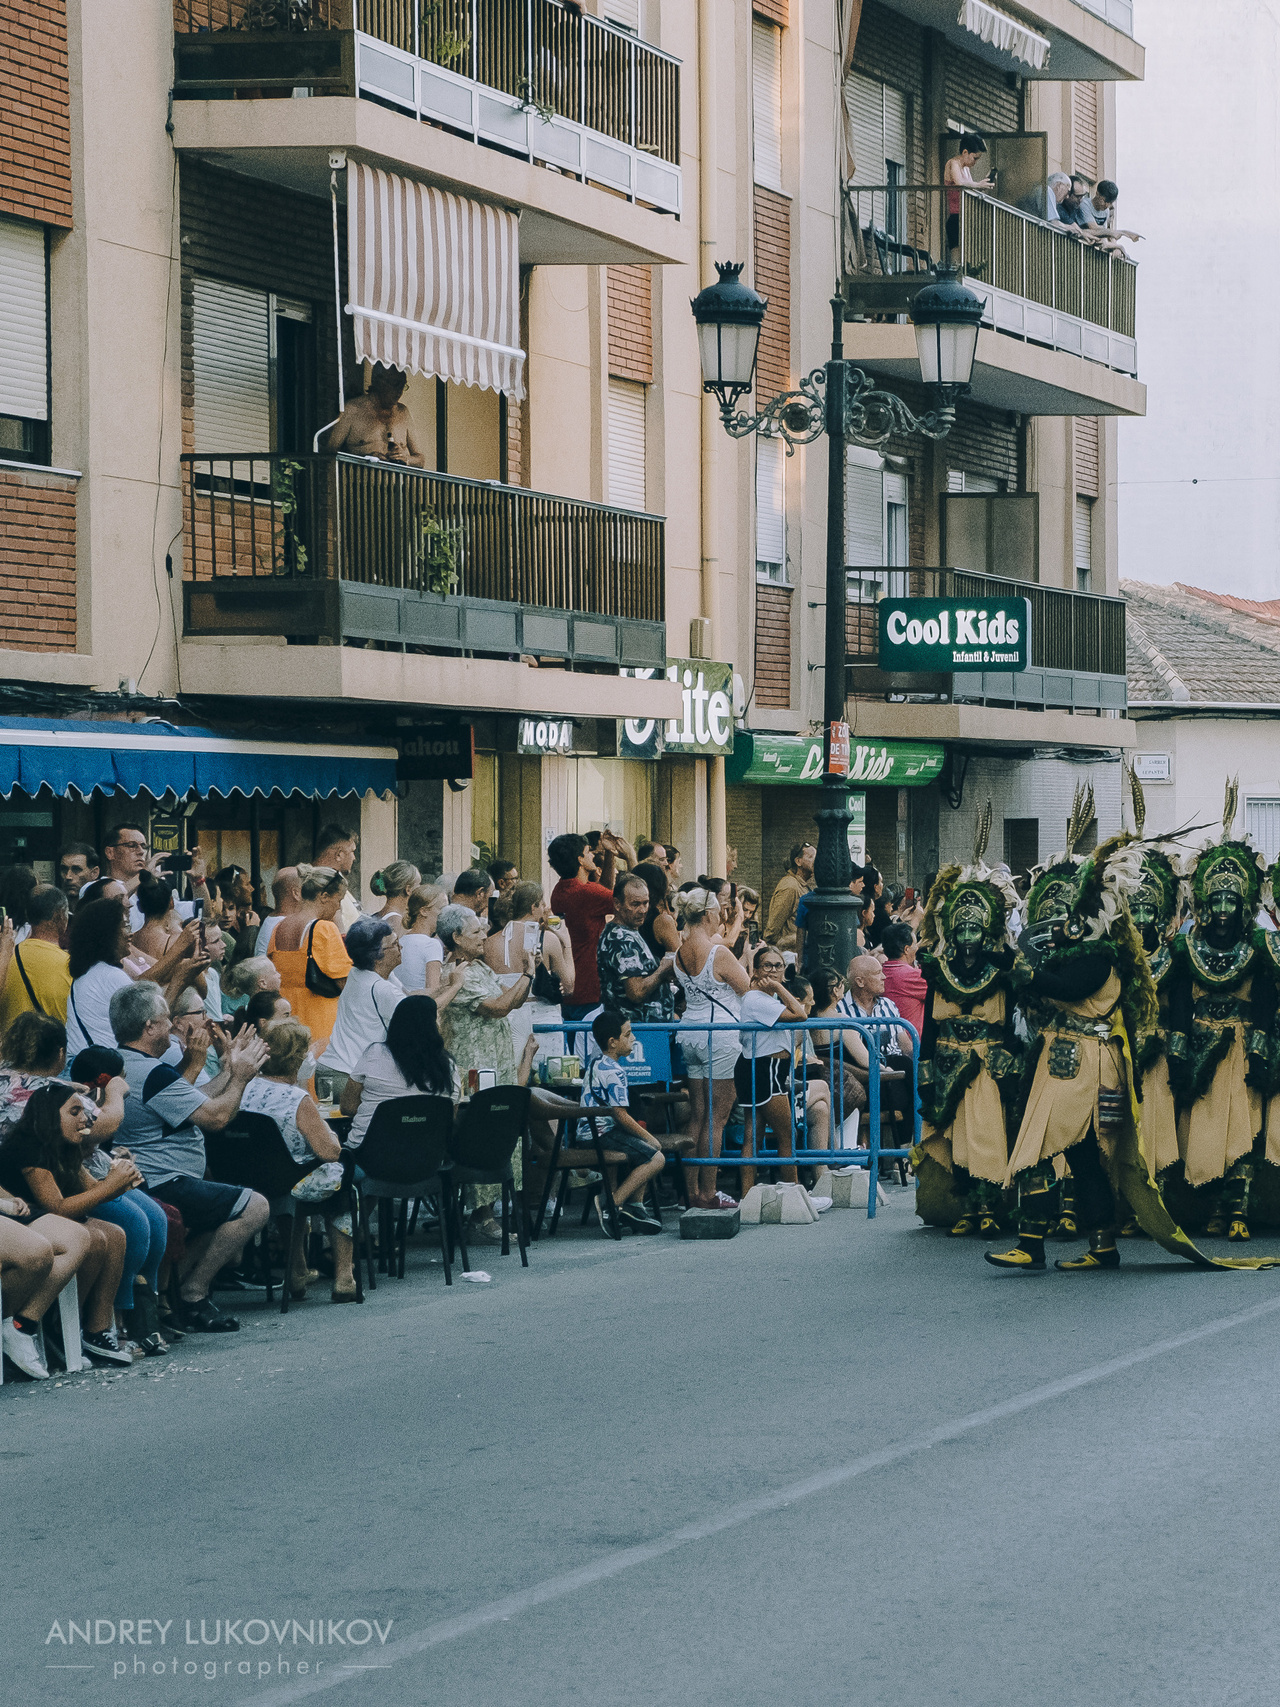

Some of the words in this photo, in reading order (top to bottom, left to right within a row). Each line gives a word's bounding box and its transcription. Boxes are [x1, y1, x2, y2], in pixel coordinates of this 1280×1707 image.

[886, 610, 950, 645] Cool
[955, 610, 1019, 645] Kids
[952, 651, 982, 663] Infantil
[983, 652, 989, 663] &
[990, 651, 1019, 663] Juvenil
[522, 721, 570, 749] MODA
[831, 743, 840, 754] DE
[847, 745, 894, 780] Kids
